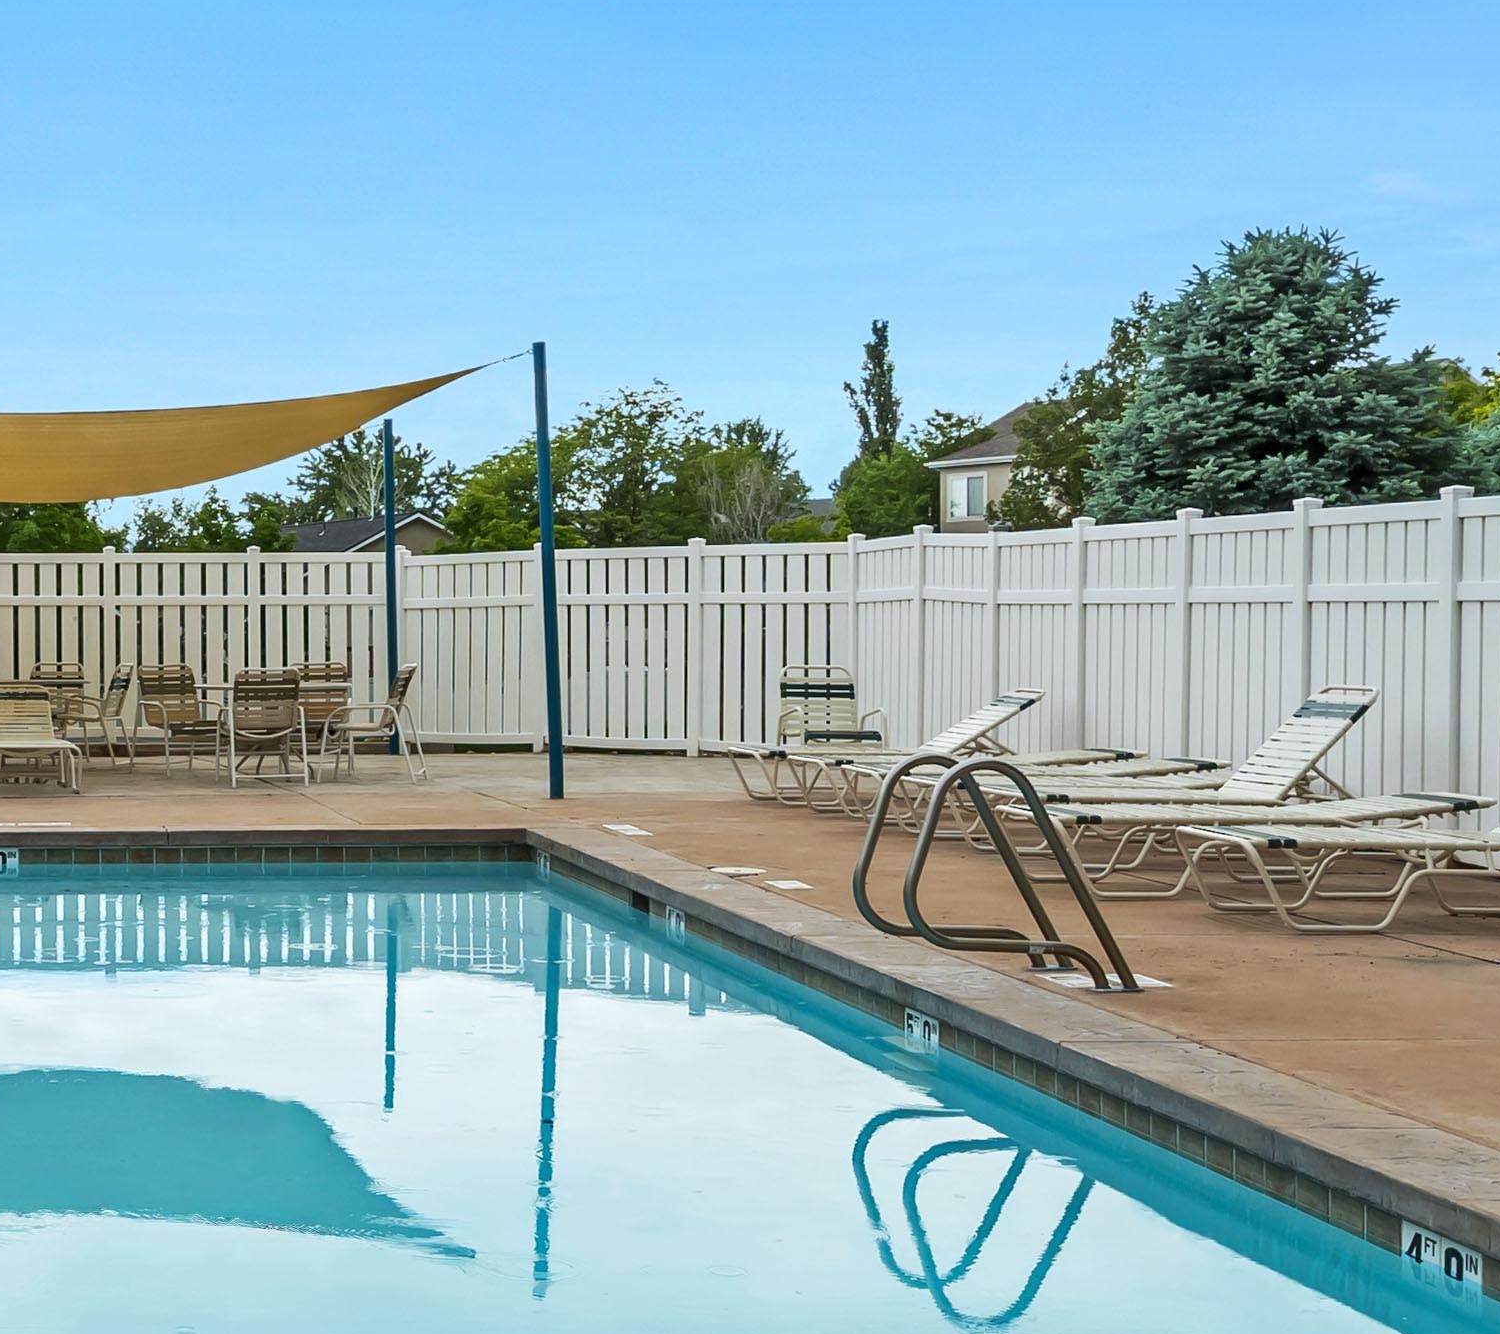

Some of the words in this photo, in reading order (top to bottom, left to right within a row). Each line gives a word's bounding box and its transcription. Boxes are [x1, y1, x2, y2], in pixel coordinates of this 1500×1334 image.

[1405, 1232, 1424, 1264] 4
[1424, 1236, 1437, 1257] FT
[1444, 1247, 1464, 1282] 0
[1465, 1253, 1478, 1276] IN
